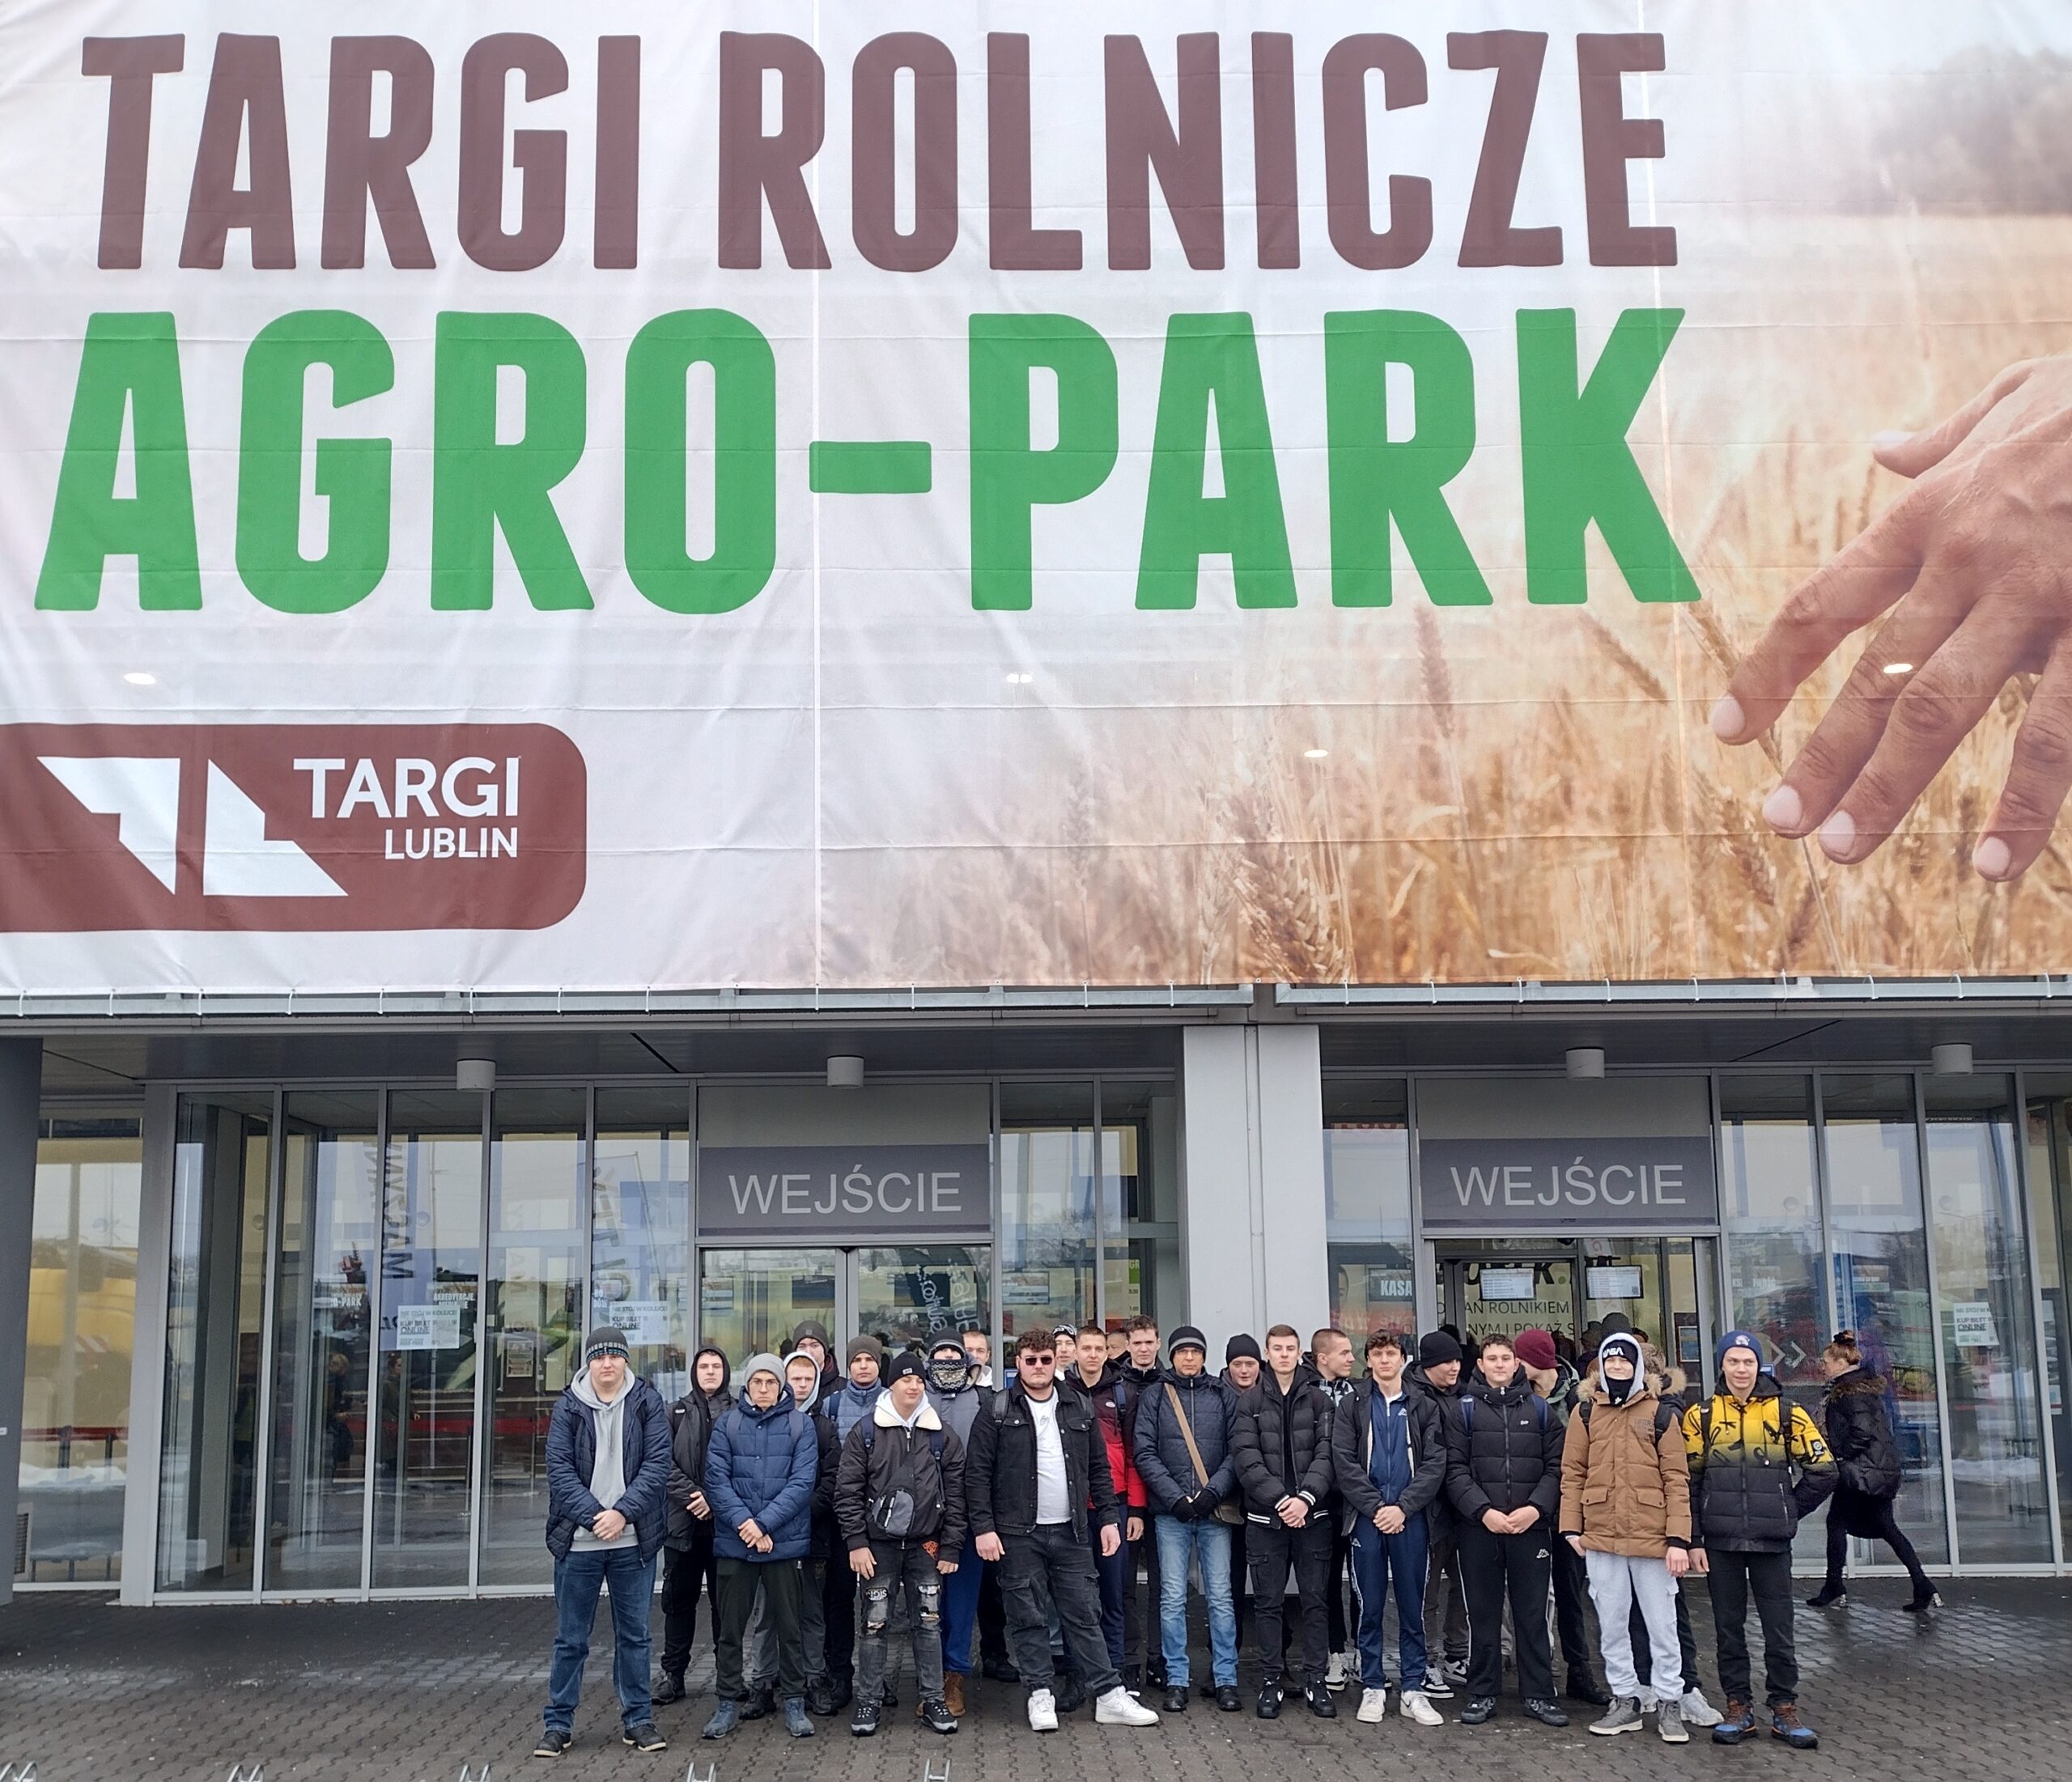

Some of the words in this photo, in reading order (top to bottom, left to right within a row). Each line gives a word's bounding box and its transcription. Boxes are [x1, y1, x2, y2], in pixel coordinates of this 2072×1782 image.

[83, 32, 640, 270] TARGI
[719, 30, 1677, 271] ROLNICZE
[35, 308, 1700, 614] AGRO-PARK
[293, 757, 519, 817] TARGI
[385, 827, 517, 859] LUBLIN
[728, 1164, 962, 1214] WEJŚCIE
[1450, 1156, 1686, 1206] WEJŚCIE
[1489, 1301, 1569, 1313] ROLNIKIEM
[1603, 1347, 1624, 1358] NASA
